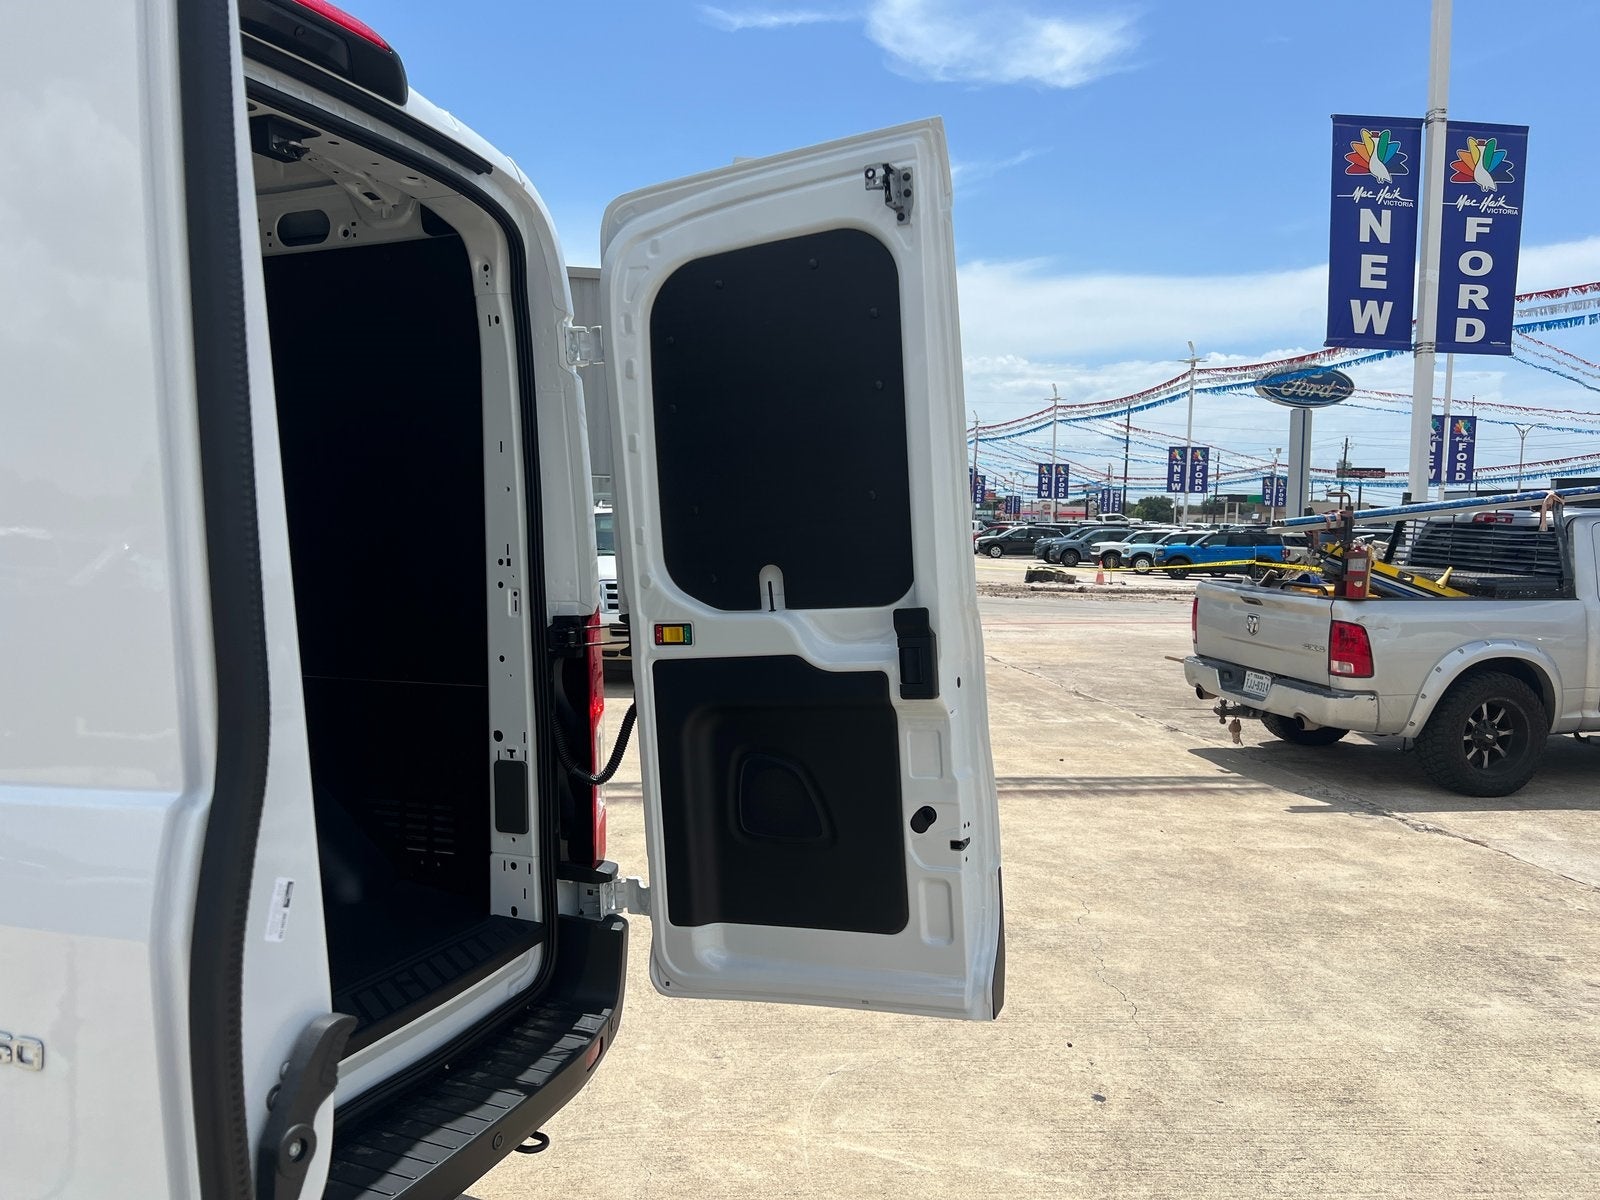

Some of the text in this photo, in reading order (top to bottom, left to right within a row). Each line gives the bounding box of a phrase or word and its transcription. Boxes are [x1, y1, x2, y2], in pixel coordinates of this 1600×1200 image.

[1352, 186, 1402, 204] Mac Haik
[1455, 194, 1506, 212] Mac Haik
[1350, 208, 1393, 335] NEW
[1455, 217, 1493, 343] FORD
[1455, 442, 1467, 481] FORD
[1040, 477, 1049, 497] NEW
[1171, 464, 1182, 491] NEW
[1194, 465, 1203, 491] FORD
